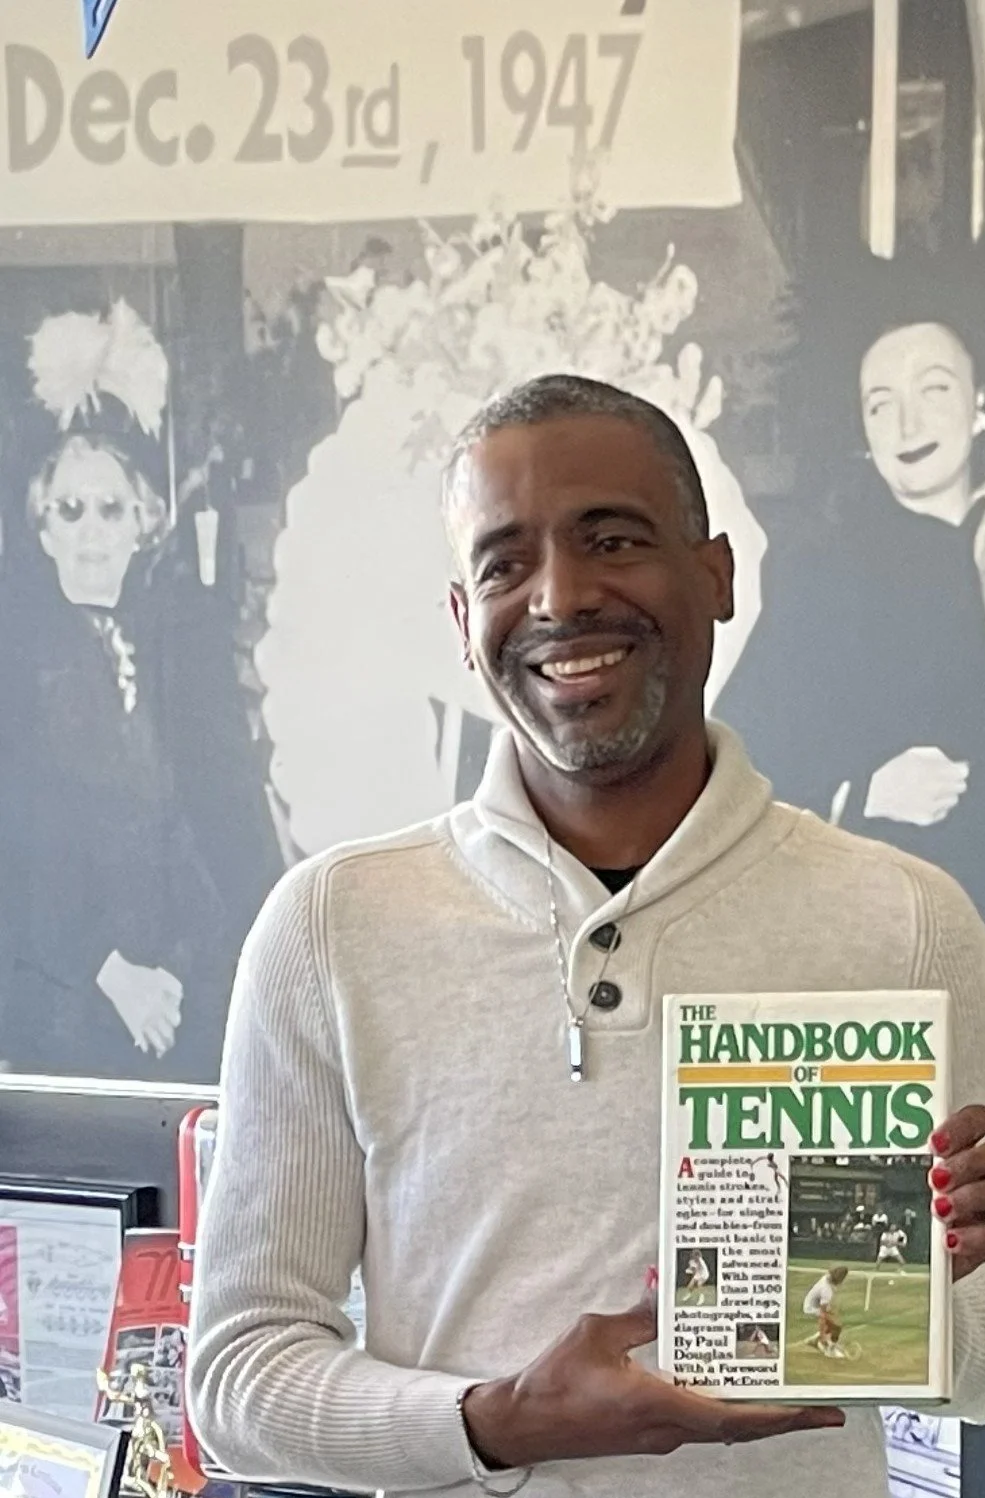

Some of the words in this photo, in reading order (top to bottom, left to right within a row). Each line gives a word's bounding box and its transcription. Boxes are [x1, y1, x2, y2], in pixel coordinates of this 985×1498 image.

[5, 43, 215, 173] Dec.
[461, 29, 642, 153] 1947
[680, 1005, 717, 1021] THE
[679, 1021, 936, 1063] HANDBOOK
[794, 1066, 819, 1083] OF
[679, 1083, 934, 1149] TENNIS
[678, 1157, 694, 1178] A
[693, 1155, 752, 1167] complete
[698, 1168, 732, 1181] guide
[677, 1182, 716, 1192] tennis
[676, 1196, 715, 1207] styles
[720, 1195, 743, 1204] and
[739, 1207, 783, 1218] singles
[676, 1221, 697, 1231] and
[675, 1234, 696, 1244] the
[699, 1234, 730, 1243] most
[734, 1233, 766, 1243] basic
[769, 1234, 783, 1243] to
[722, 1246, 743, 1256] the
[749, 1246, 781, 1256] most
[722, 1271, 748, 1281] With
[752, 1273, 781, 1281] more
[721, 1284, 748, 1294] than
[756, 1310, 779, 1319] and
[674, 1336, 694, 1350] By
[696, 1335, 728, 1347] Paul
[674, 1349, 734, 1363] Douglas
[674, 1363, 704, 1373] With
[707, 1365, 715, 1373] a
[720, 1362, 778, 1373] Foreword
[674, 1375, 688, 1388] by
[689, 1376, 721, 1386] John
[723, 1376, 780, 1386] McEnroe
